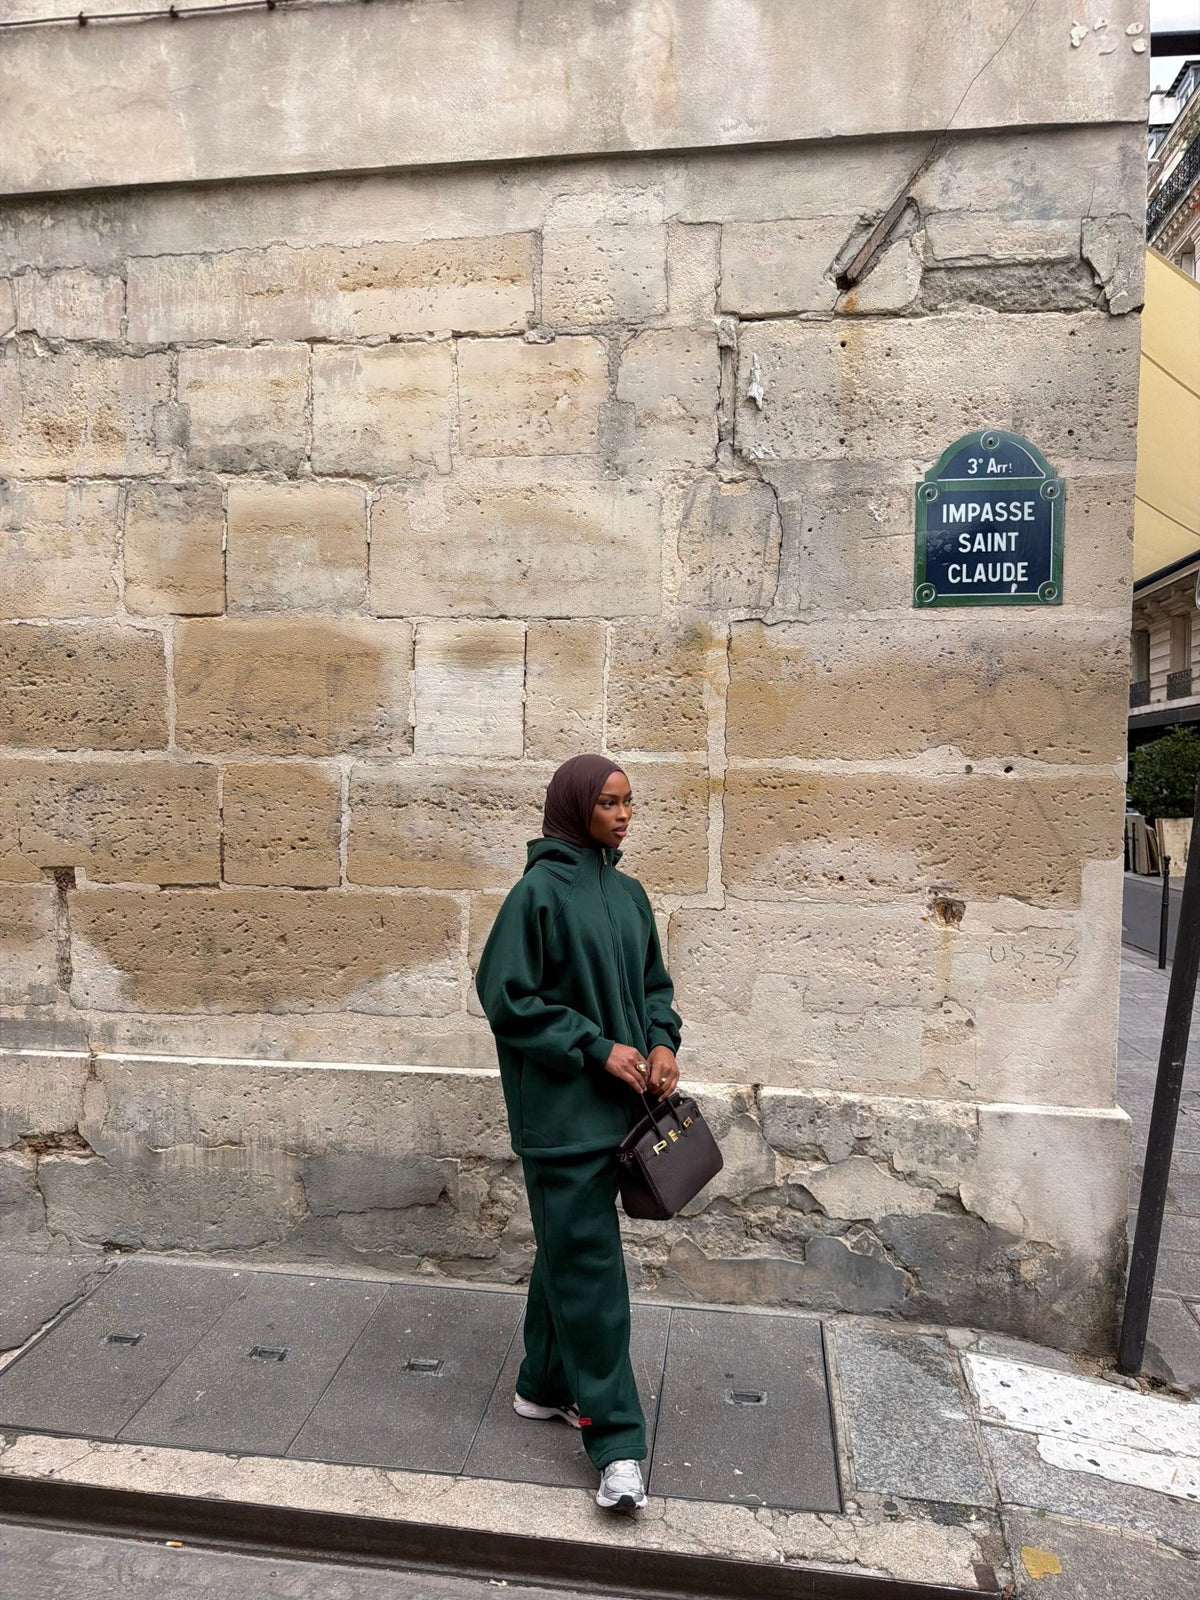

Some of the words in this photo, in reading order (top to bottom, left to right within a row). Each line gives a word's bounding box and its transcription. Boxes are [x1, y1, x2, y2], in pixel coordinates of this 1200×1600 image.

[942, 501, 1036, 524] IMPASSE
[958, 532, 1019, 553] SAINT
[947, 562, 1029, 584] CLAUDE
